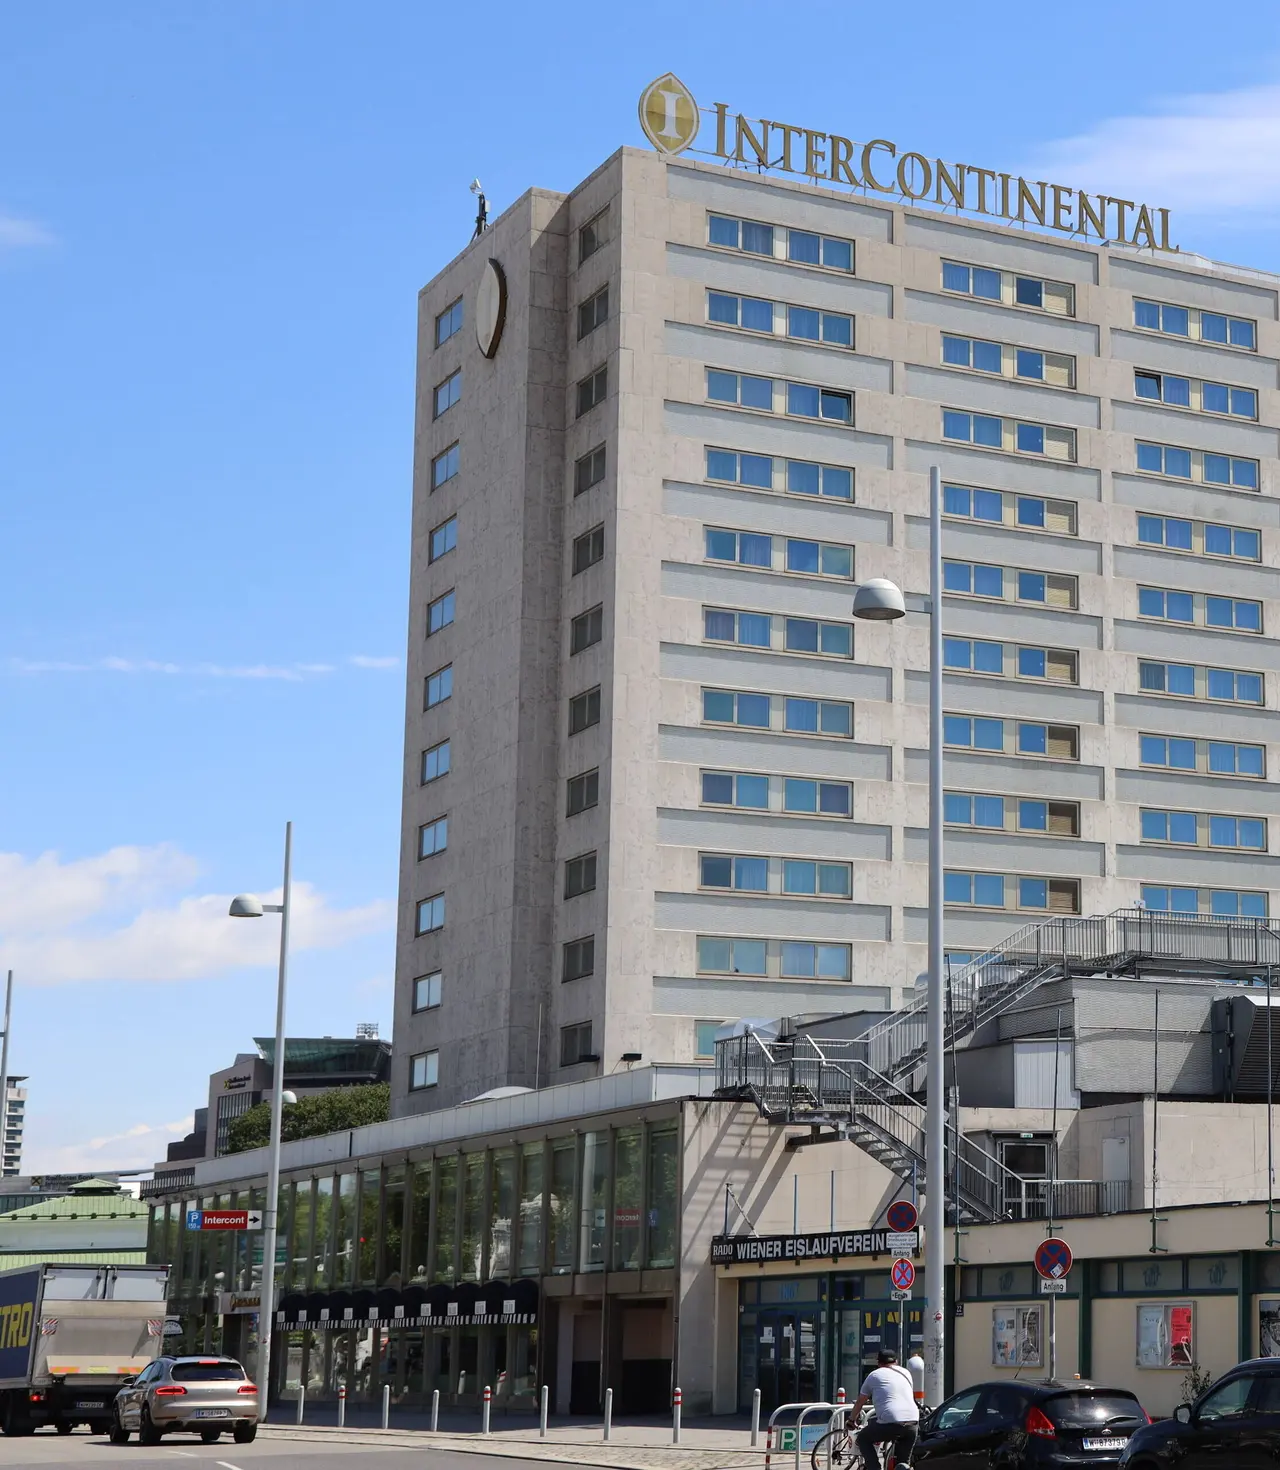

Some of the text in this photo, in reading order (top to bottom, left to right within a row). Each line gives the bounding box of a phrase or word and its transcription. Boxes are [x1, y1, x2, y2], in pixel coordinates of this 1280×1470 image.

[204, 1216, 245, 1224] Intercont
[712, 1243, 733, 1256] RADO
[736, 1233, 885, 1260] WIENER EISLAUFVEREIN
[1043, 1282, 1064, 1292] Anfang
[0, 1302, 33, 1349] TRO
